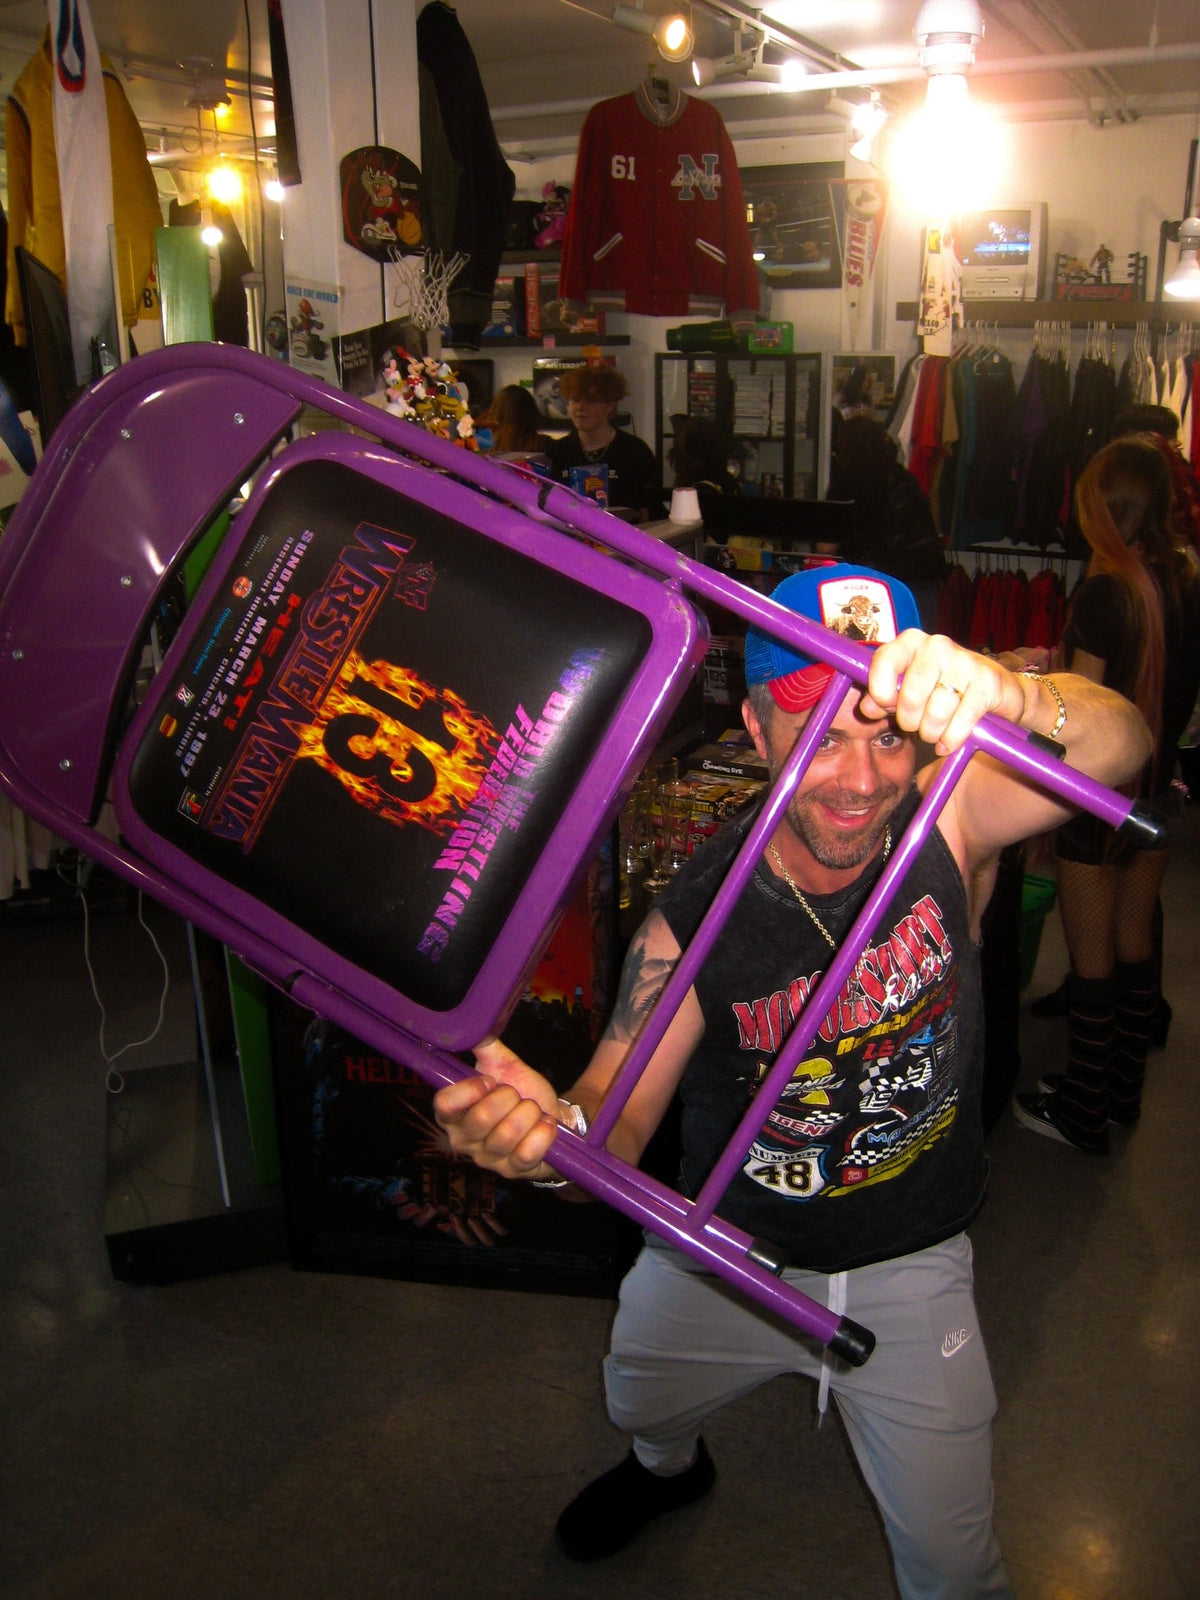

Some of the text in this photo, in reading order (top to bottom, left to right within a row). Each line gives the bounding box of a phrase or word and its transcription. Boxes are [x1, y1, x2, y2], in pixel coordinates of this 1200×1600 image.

[611, 154, 636, 180] 61
[678, 153, 719, 200] N
[846, 219, 868, 288] BLUES
[261, 536, 294, 593] ROSEMONT
[233, 596, 262, 642] HORIZON
[180, 530, 314, 778] SUNDAY, MARCH 23, 1997
[175, 711, 201, 757] ILLINOIS
[415, 647, 603, 964] WORLD WRESTLING
[431, 702, 535, 872] FEDERATION
[752, 1160, 812, 1193] 48
[944, 1328, 966, 1349] NIKE
